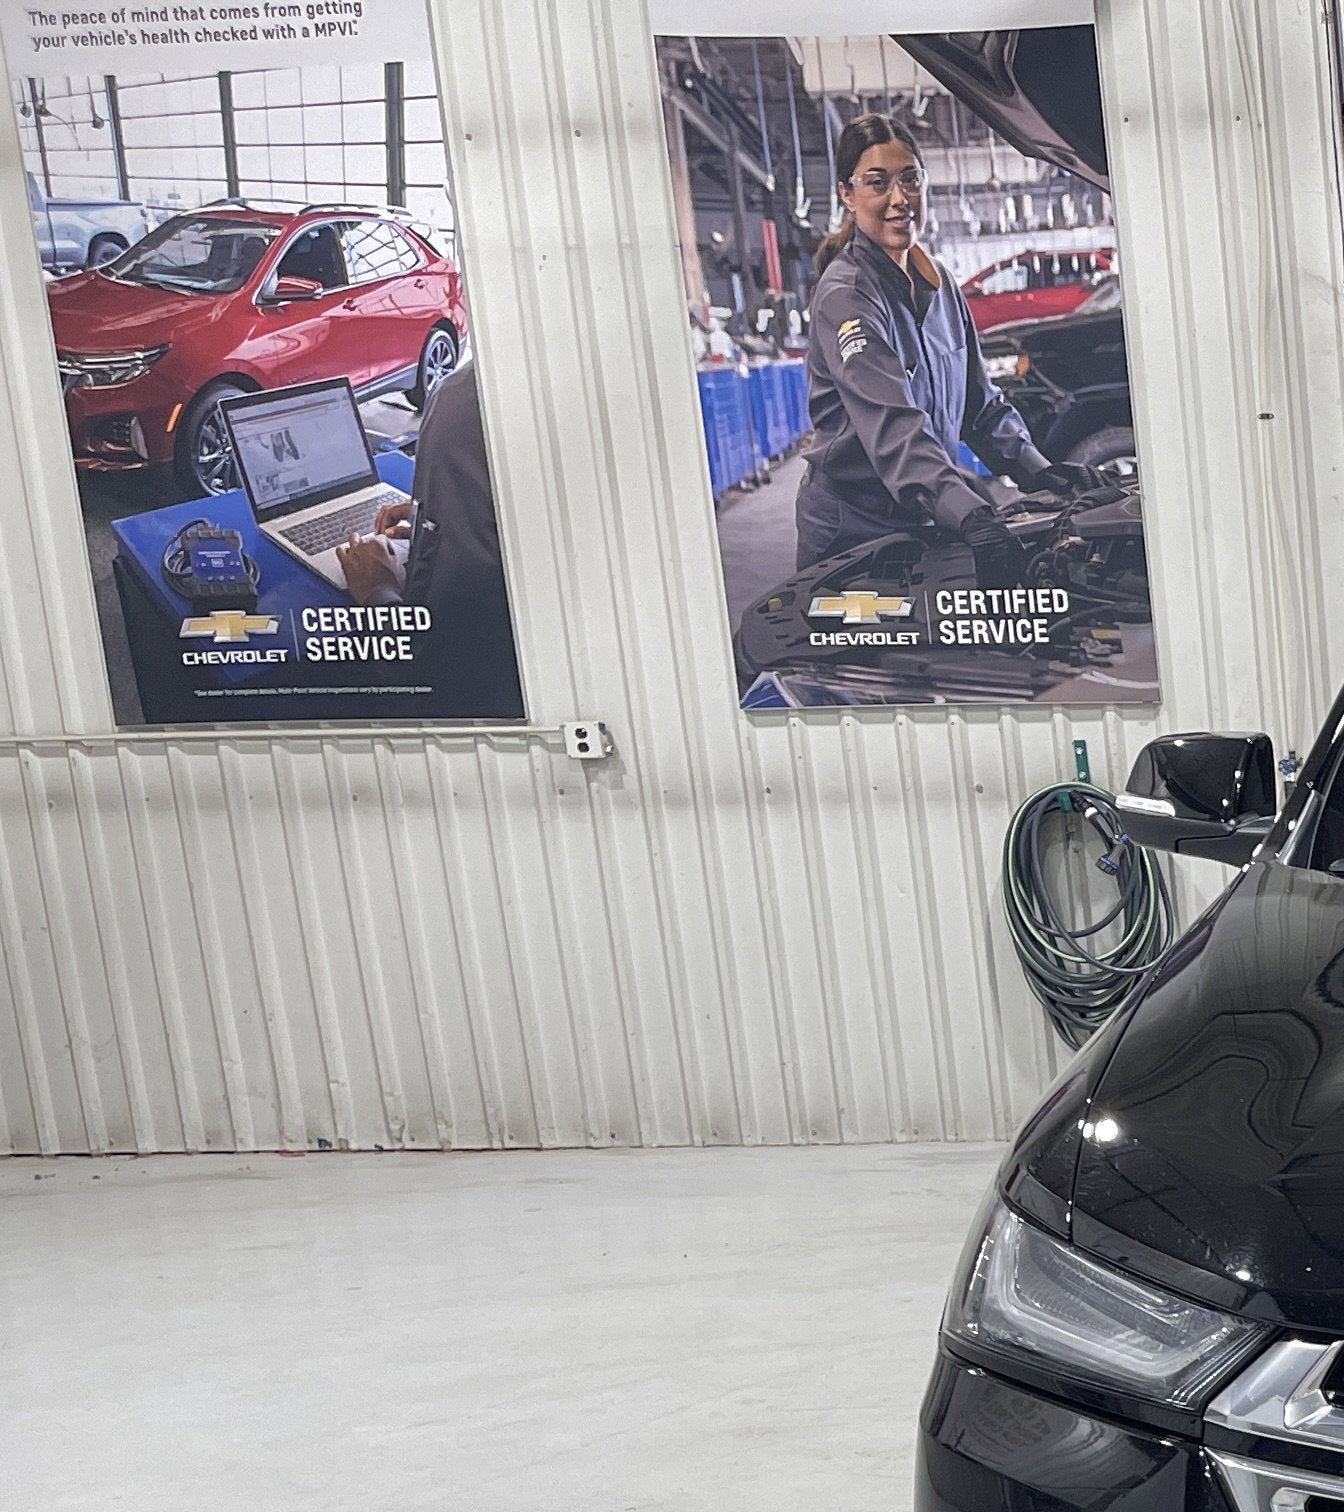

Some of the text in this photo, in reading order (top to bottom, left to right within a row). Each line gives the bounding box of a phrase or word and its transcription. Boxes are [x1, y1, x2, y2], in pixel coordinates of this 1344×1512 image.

[28, 0, 363, 29] The peace of mind that comes from getting
[33, 35, 67, 52] your
[71, 30, 138, 47] vehicle's
[141, 29, 191, 45] health
[194, 25, 258, 43] checked
[262, 24, 297, 40] with
[301, 26, 310, 38] a
[936, 588, 1070, 615] CERTIFIED
[301, 606, 432, 632] CERTIFIED
[938, 618, 1050, 645] SERVICE
[305, 635, 414, 662] SERVICE
[809, 632, 920, 646] CHEVROLET
[181, 649, 289, 666] CHEVROLET
